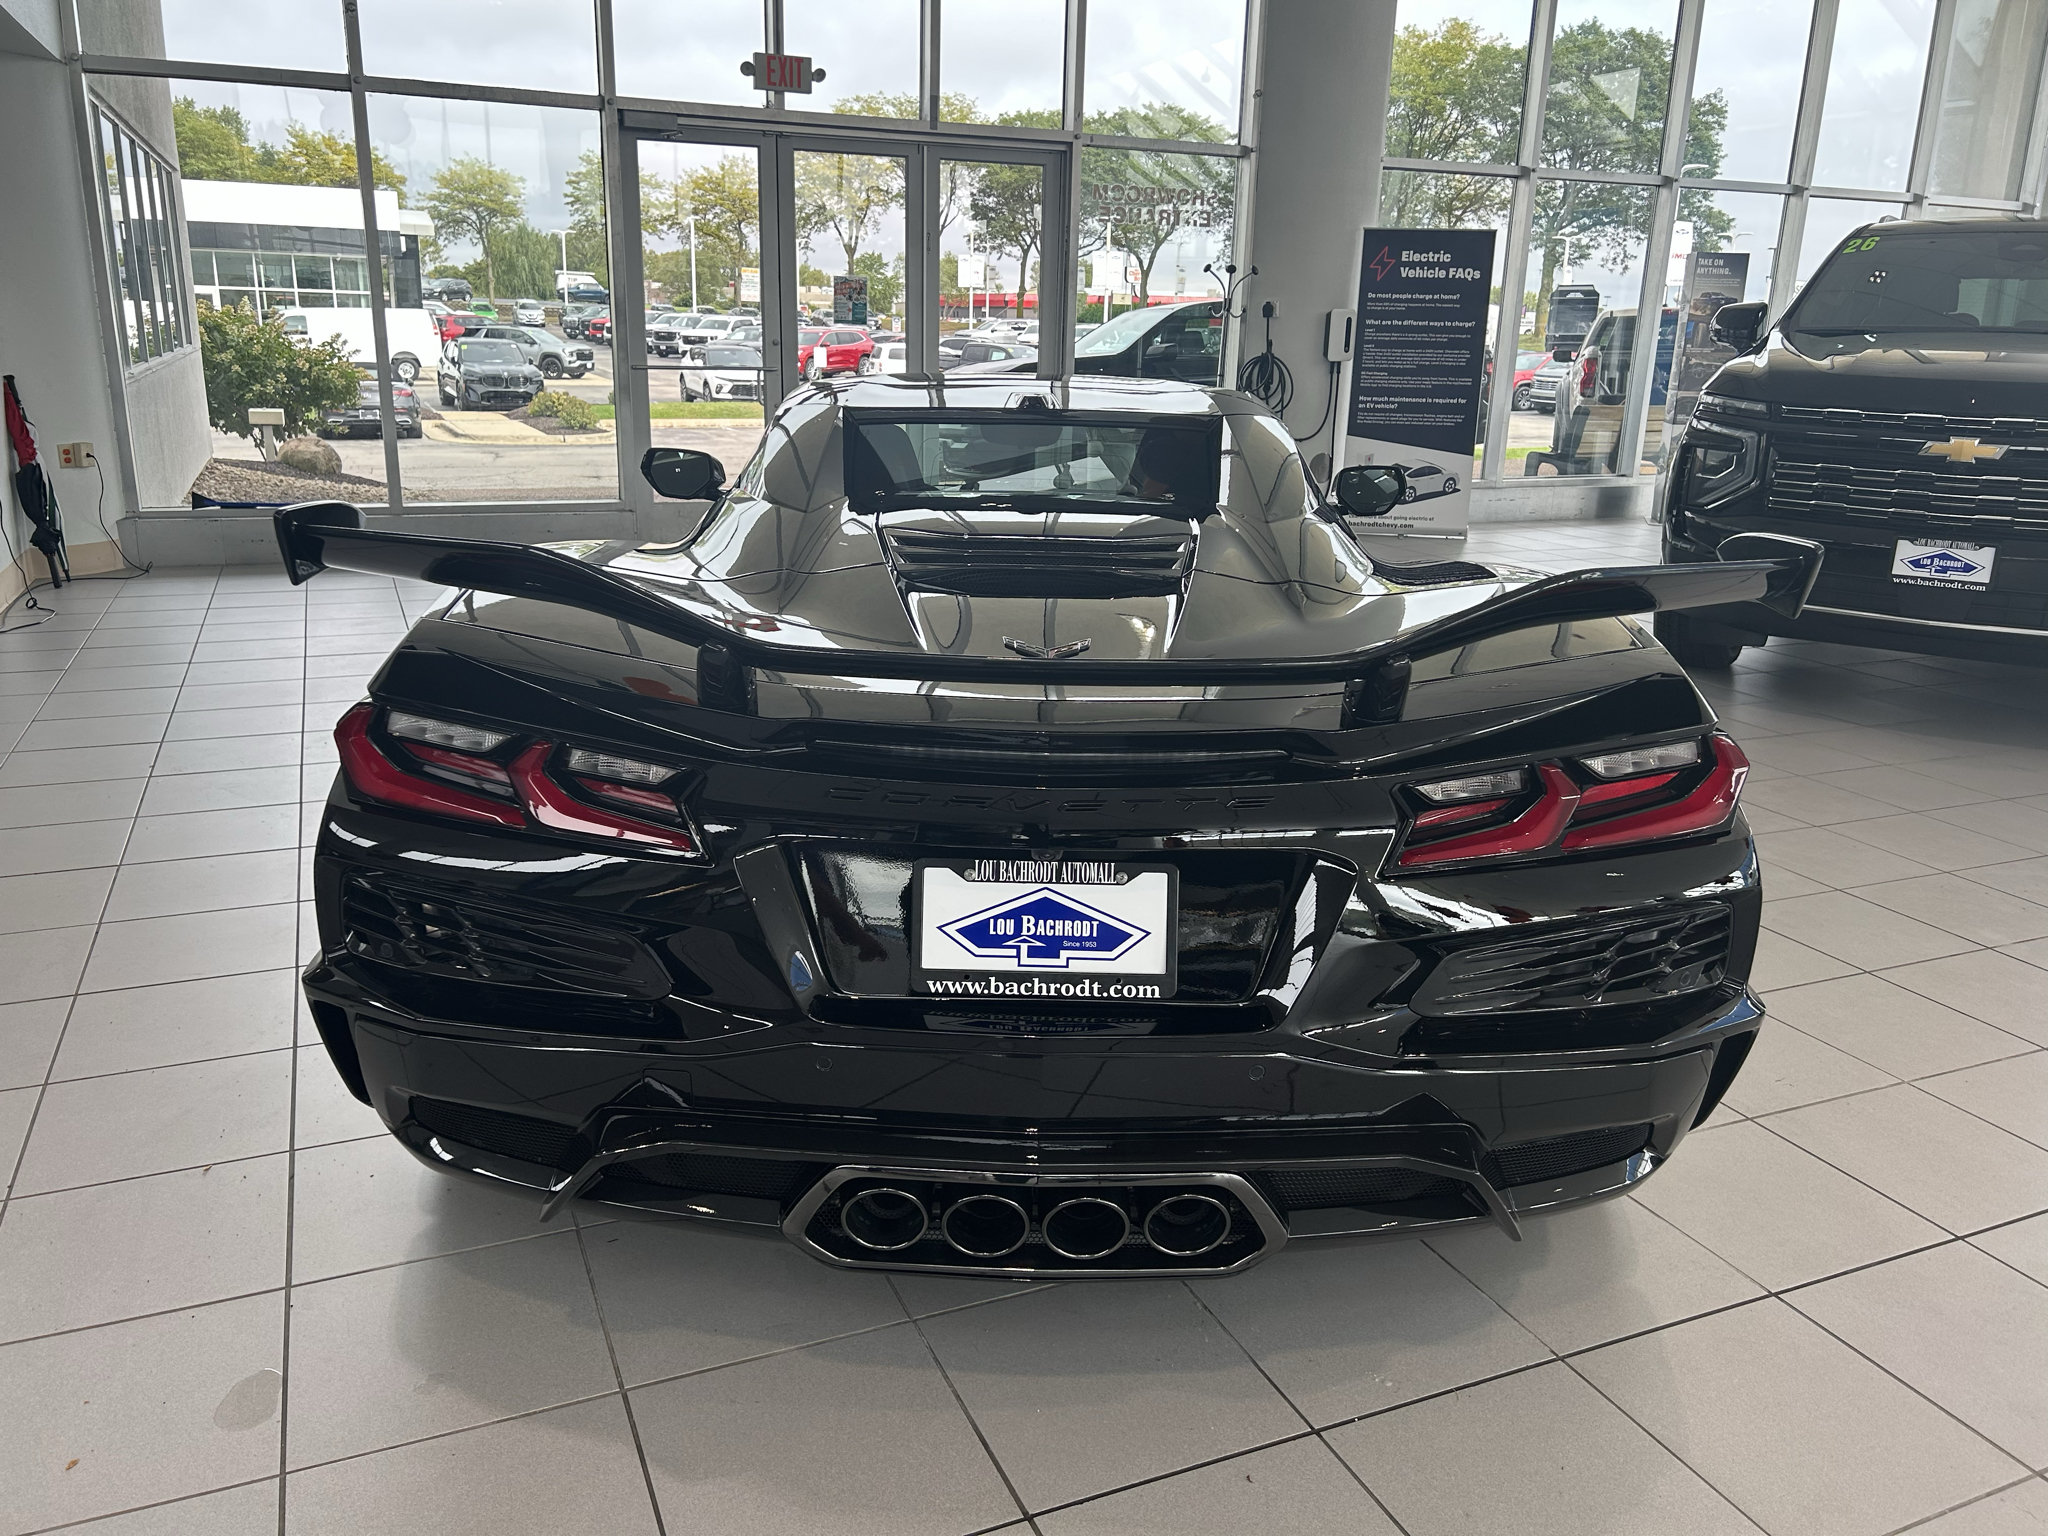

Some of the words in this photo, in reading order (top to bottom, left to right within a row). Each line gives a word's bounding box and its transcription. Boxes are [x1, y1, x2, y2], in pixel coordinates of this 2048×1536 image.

[767, 55, 803, 88] EXIT
[1842, 237, 1880, 253] 26
[1401, 251, 1451, 262] Electric
[1698, 258, 1713, 266] TAKE
[1400, 267, 1446, 278] Vehicle
[1449, 268, 1480, 280] FAQs
[1933, 558, 1965, 568] BACHRODT
[1893, 577, 1986, 591] www.bachrodt.com
[825, 787, 1276, 813] CORVETTE
[975, 860, 997, 880] LOU
[999, 860, 1059, 883] BACHRODT
[1061, 862, 1117, 884] AUTOMALL
[989, 918, 1014, 935] LOU
[1020, 915, 1099, 937] BACHRODT
[926, 976, 1161, 998] www.bachrodt.com
